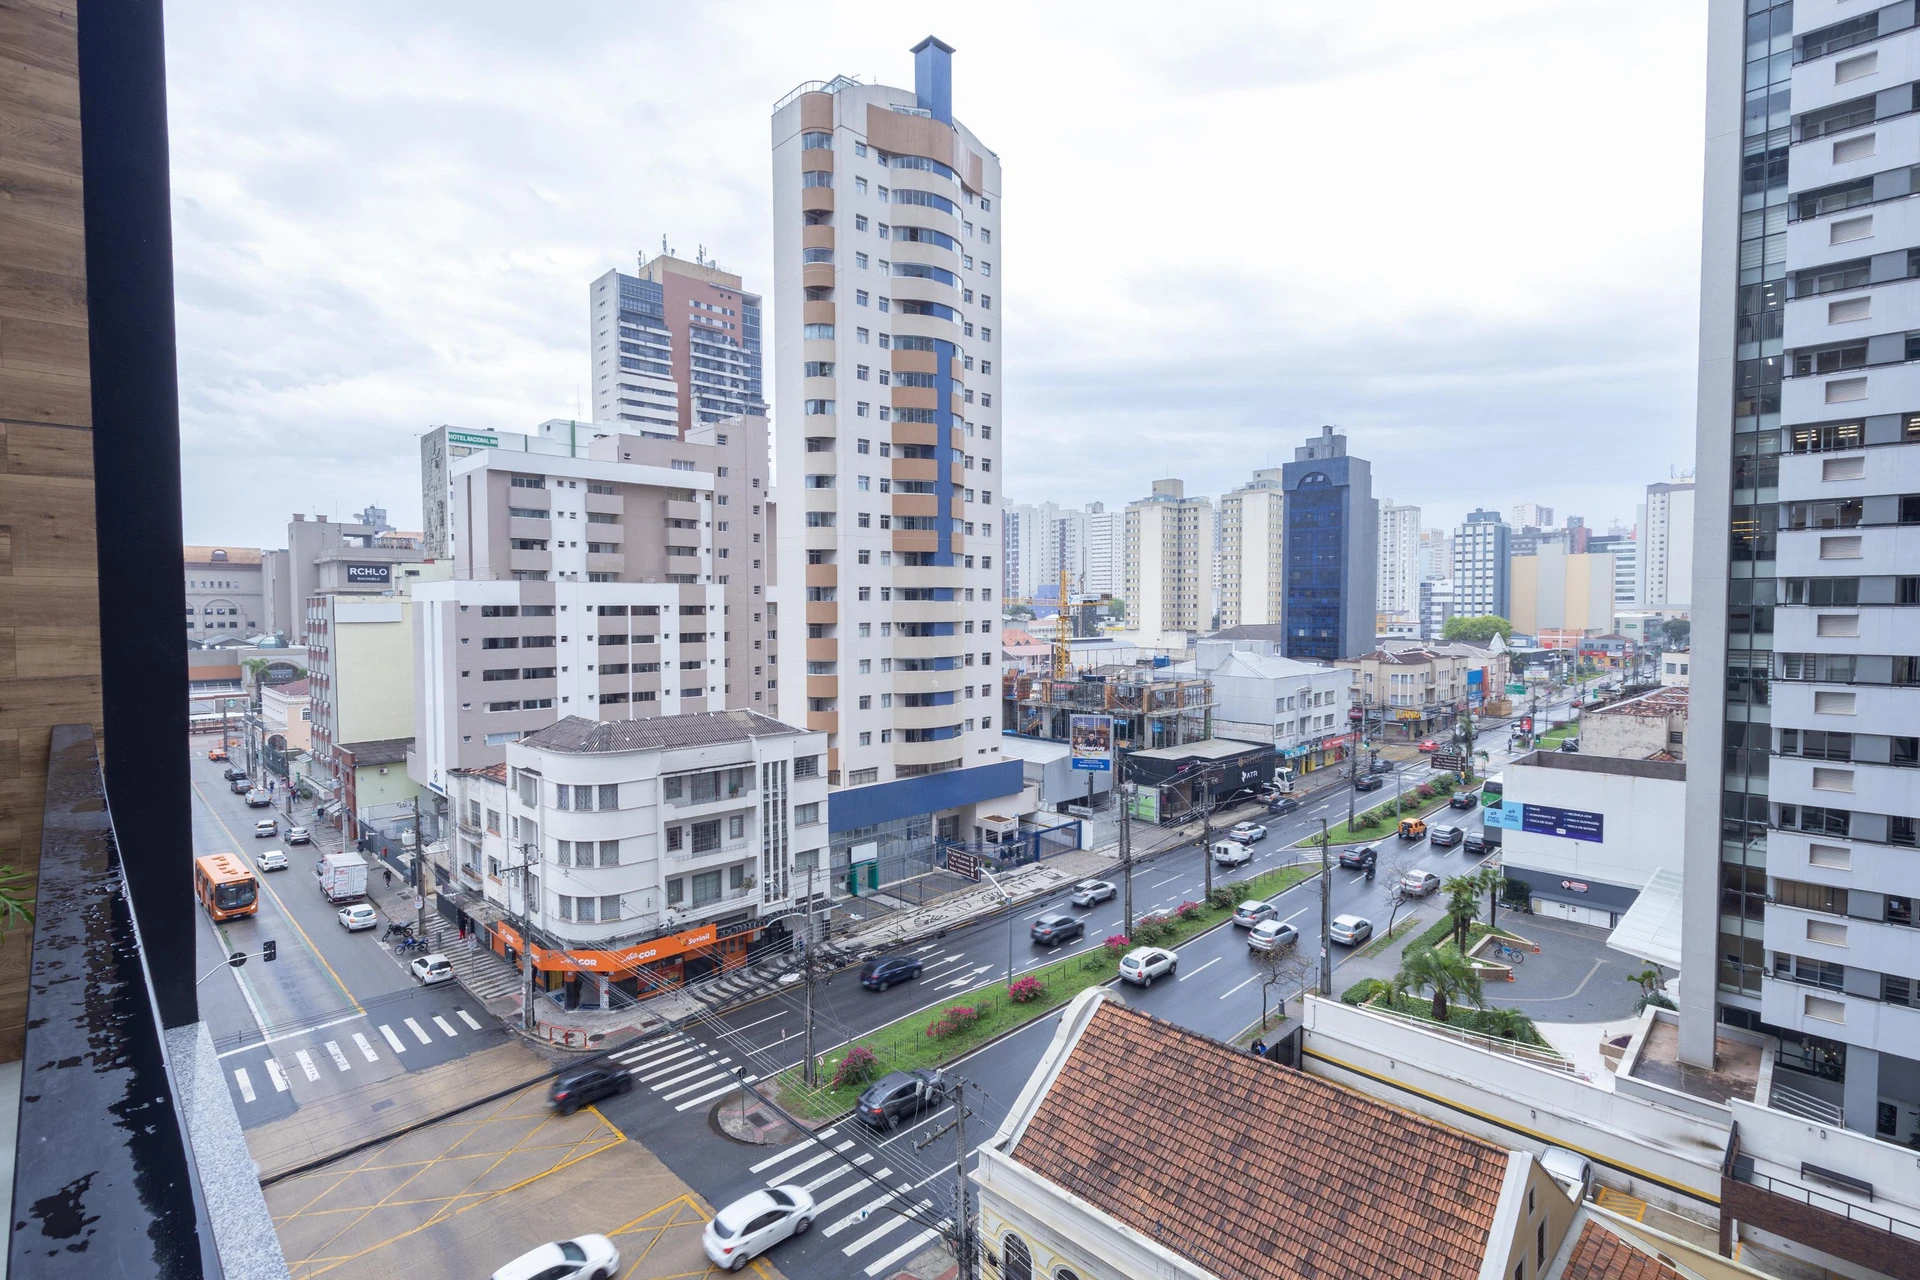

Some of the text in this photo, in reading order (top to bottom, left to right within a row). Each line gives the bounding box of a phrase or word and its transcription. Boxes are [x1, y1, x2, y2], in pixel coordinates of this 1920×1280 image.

[350, 567, 387, 576] RCHLO
[1246, 770, 1258, 779] ATR
[688, 934, 710, 945] Suvinil
